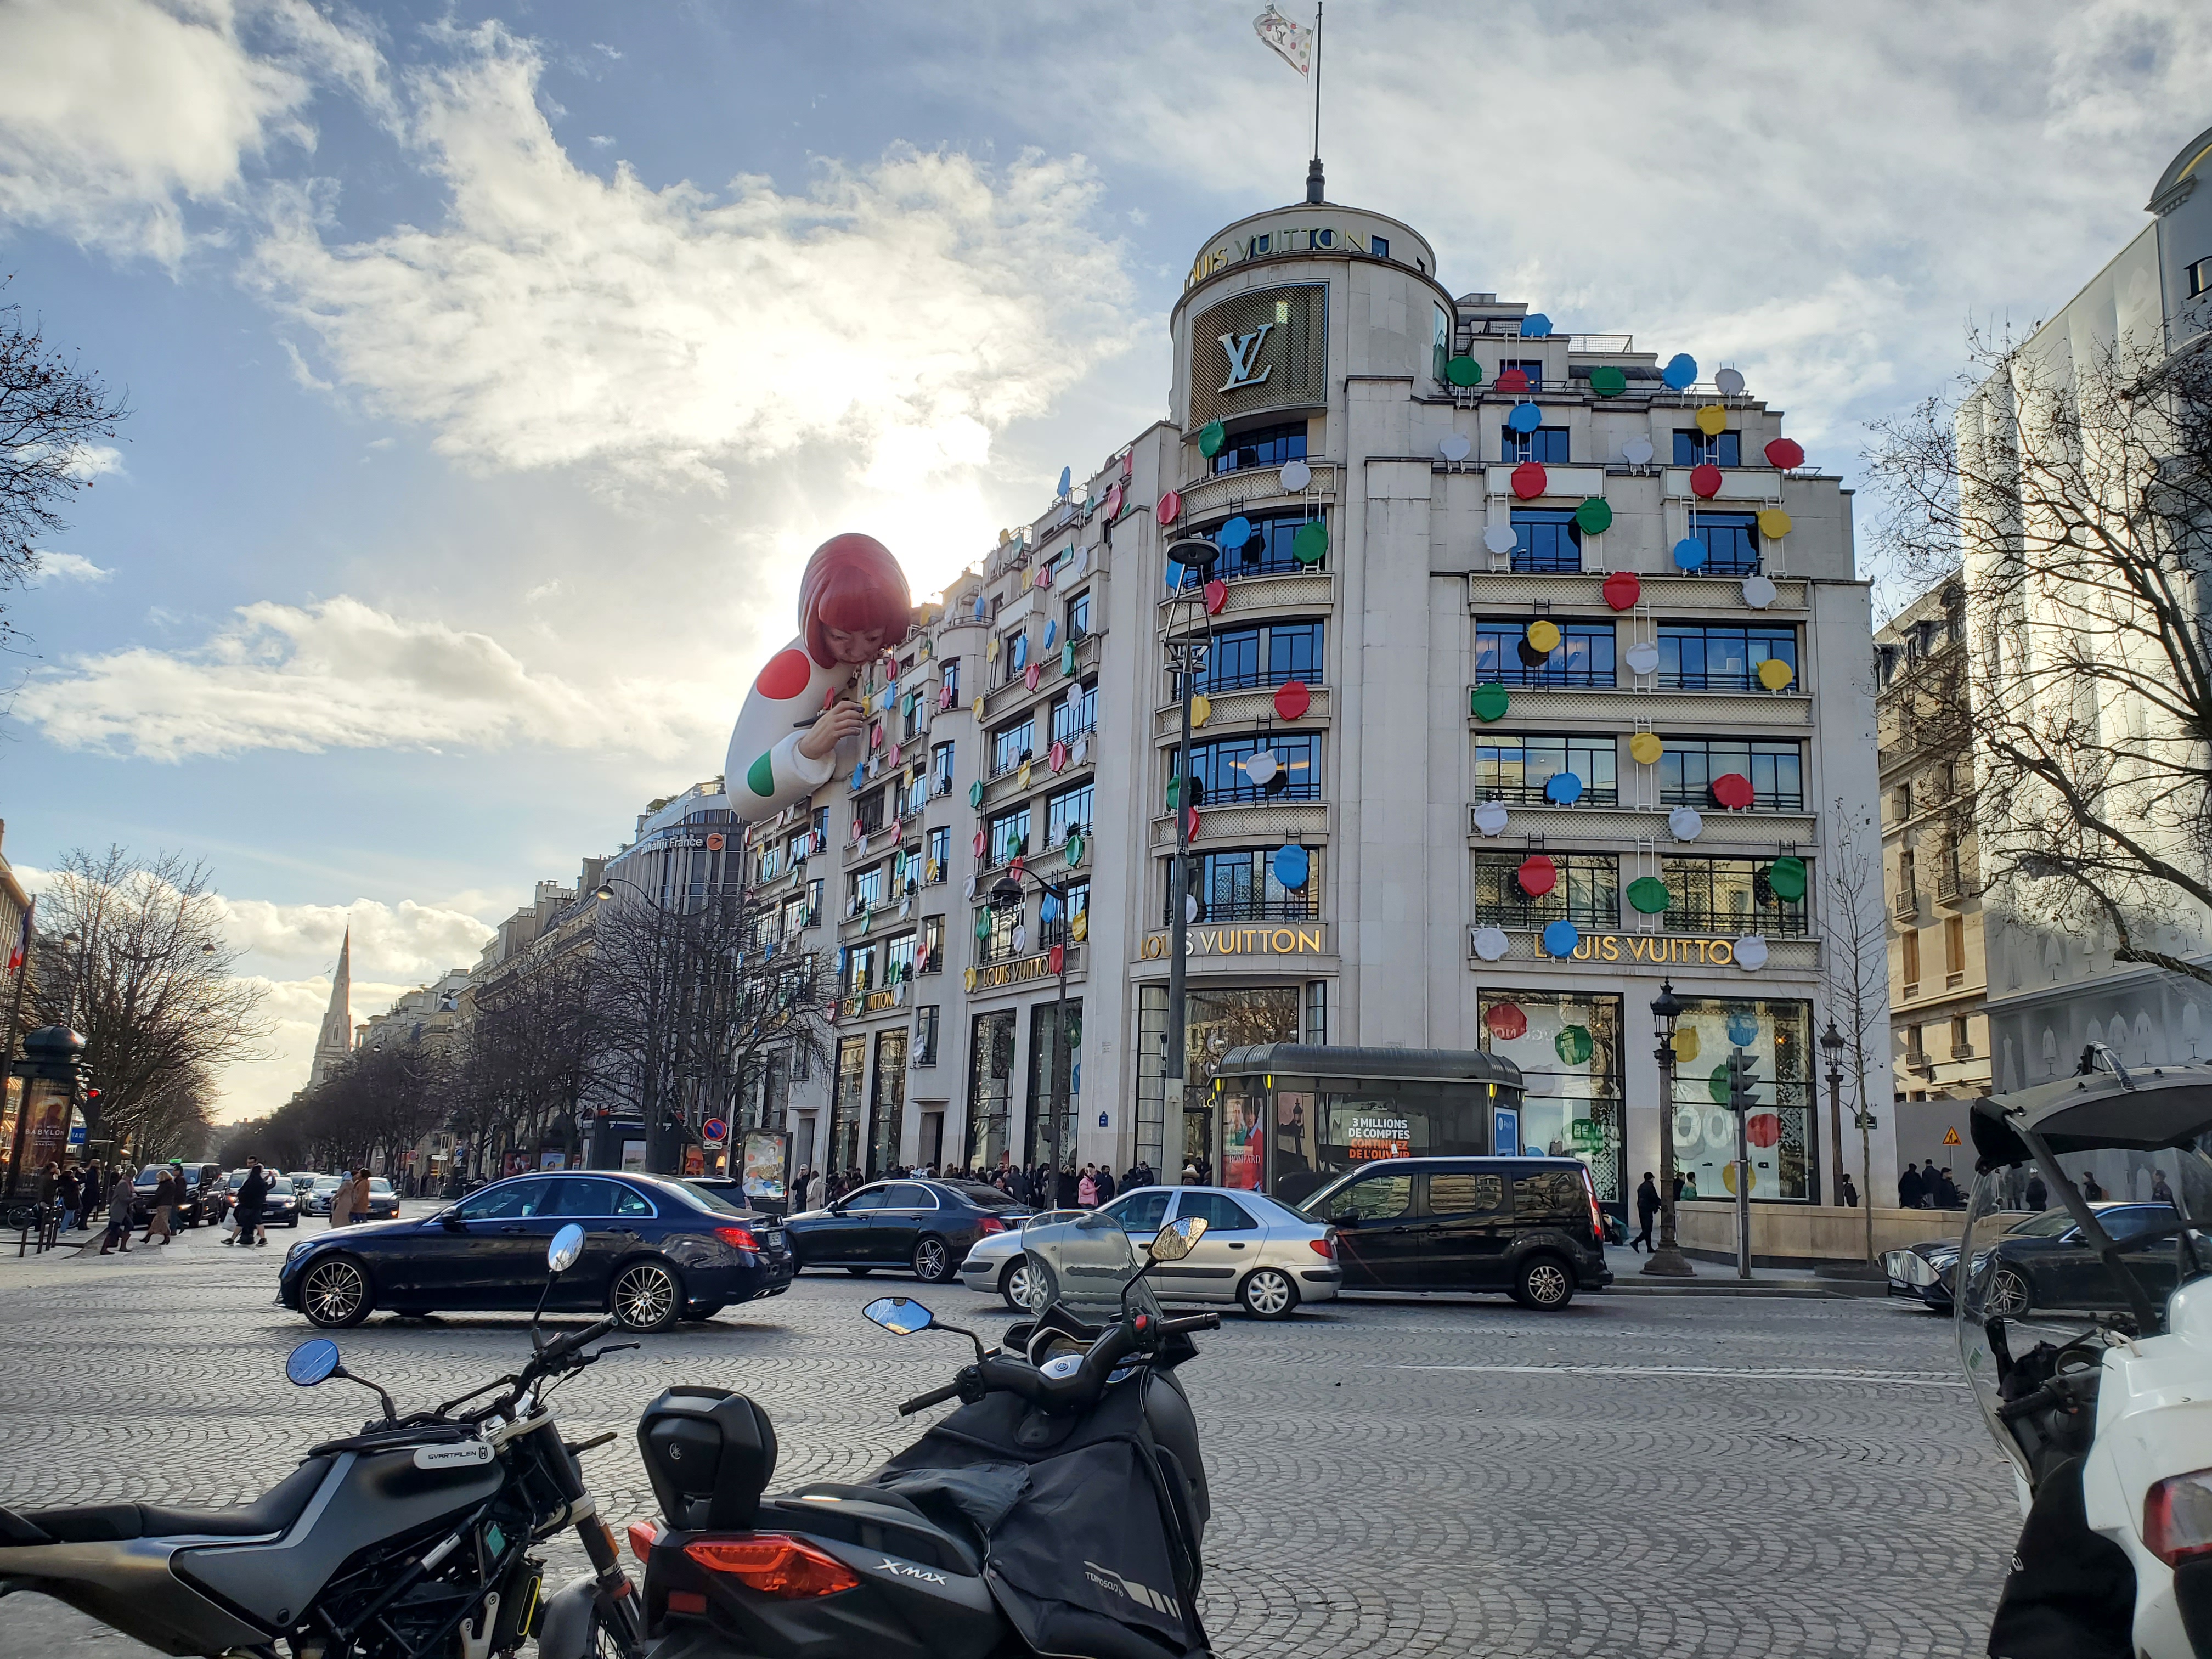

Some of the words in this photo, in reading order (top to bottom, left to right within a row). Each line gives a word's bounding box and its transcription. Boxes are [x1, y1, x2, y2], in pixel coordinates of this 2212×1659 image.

[1235, 226, 1365, 260] VUITTON
[669, 838, 703, 848] France
[1141, 933, 1194, 959] LOUS
[1200, 928, 1320, 954] VUITTON
[1534, 934, 1620, 961] LUIS
[1626, 937, 1733, 964] VUITTO
[983, 964, 1011, 987] LOUIS
[1013, 956, 1052, 981] VUITTO
[1352, 1118, 1359, 1127] 3
[1361, 1118, 1408, 1129] MILLIONS
[1348, 1128, 1362, 1137] DE
[1363, 1128, 1410, 1139] COMPTES
[1229, 1155, 1261, 1164] BOMPARD
[1349, 1149, 1362, 1159] DE
[428, 1451, 477, 1460] SVARTPILEN
